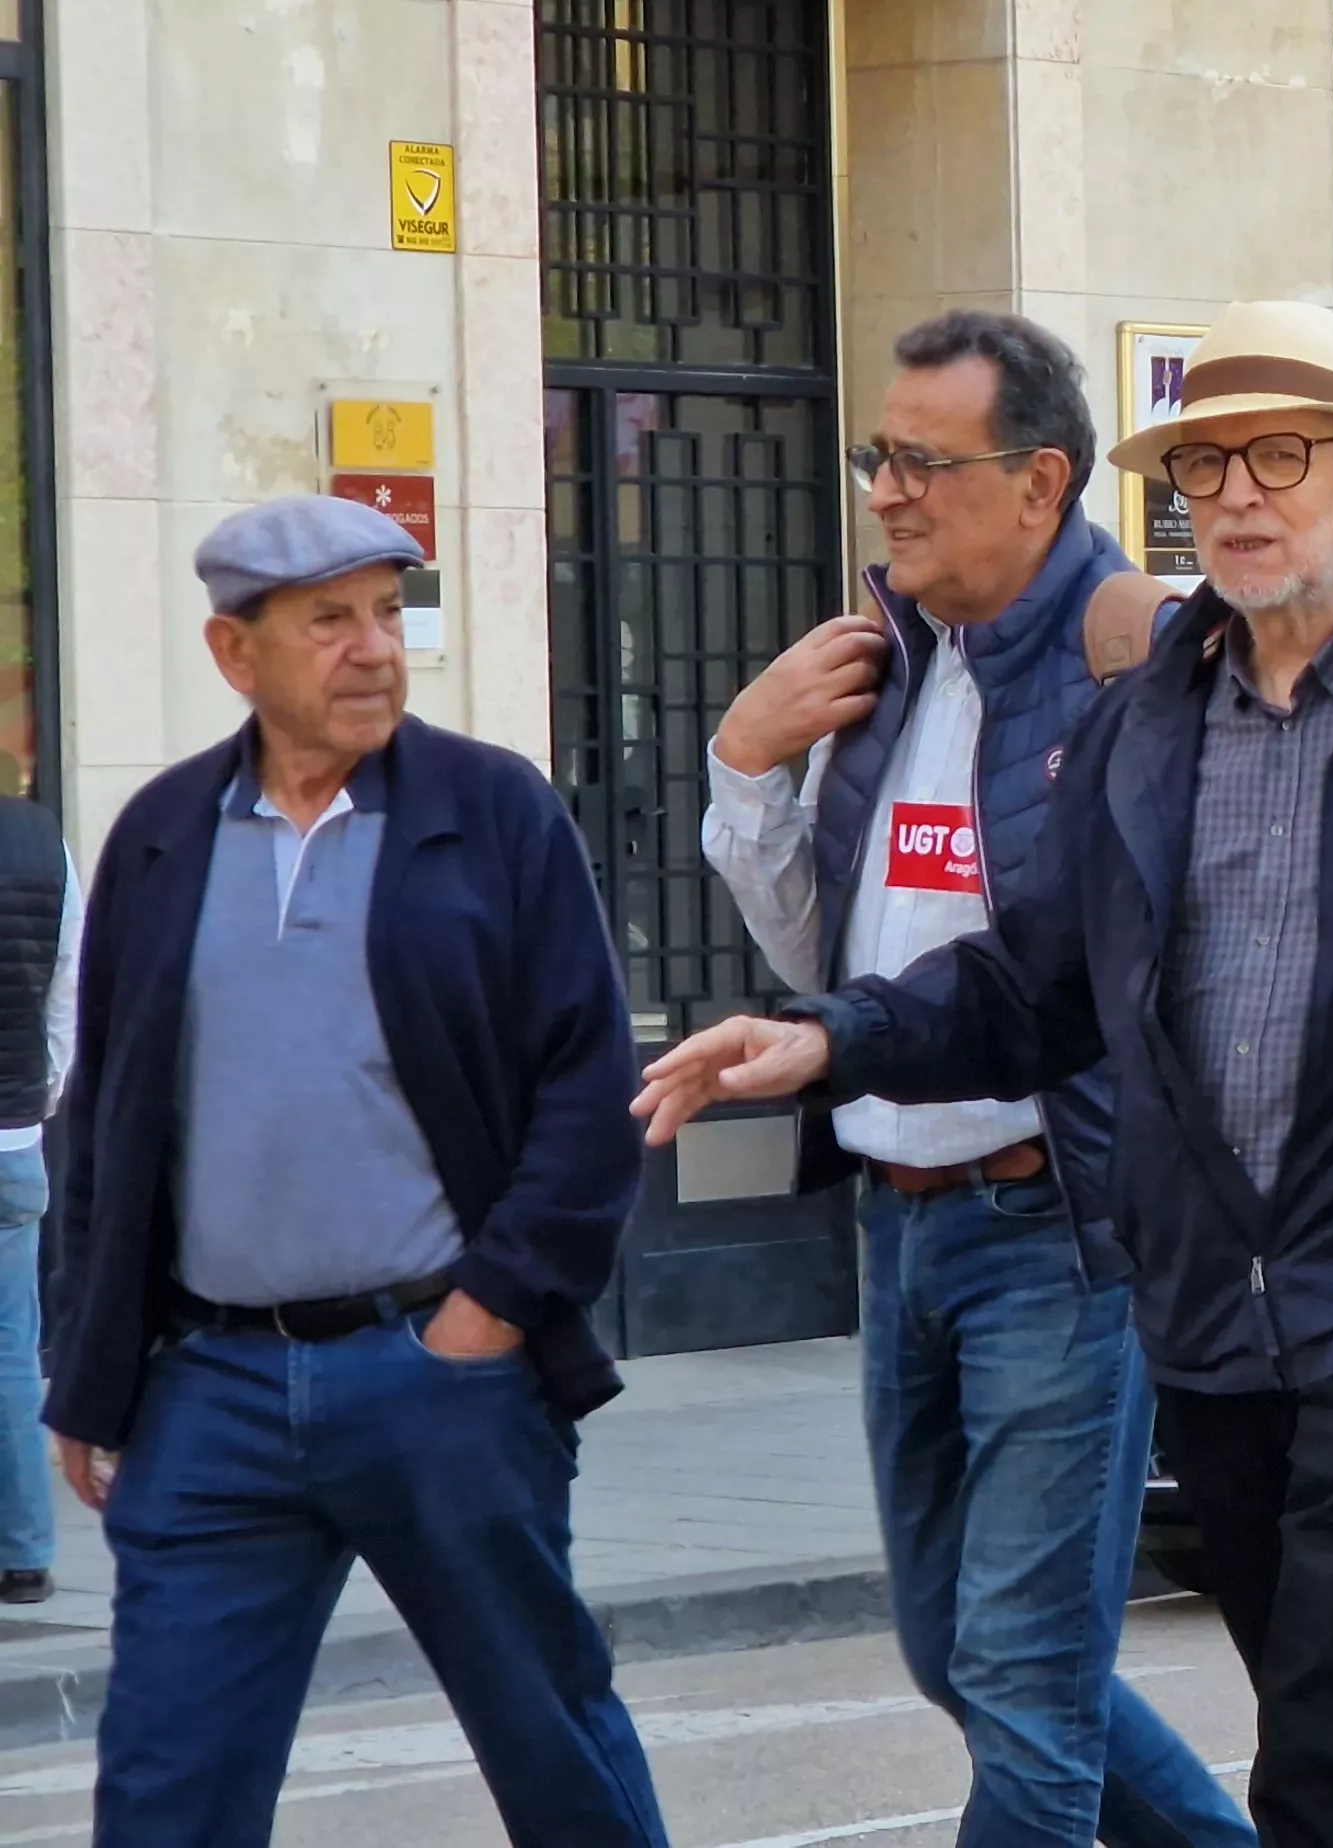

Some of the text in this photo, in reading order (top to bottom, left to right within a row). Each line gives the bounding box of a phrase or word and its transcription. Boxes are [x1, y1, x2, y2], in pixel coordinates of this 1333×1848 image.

[404, 144, 441, 155] ALARMA
[398, 155, 446, 167] CONECTADA
[398, 218, 450, 236] VISEGUR
[898, 823, 951, 856] UGT
[943, 860, 980, 878] Aragó
